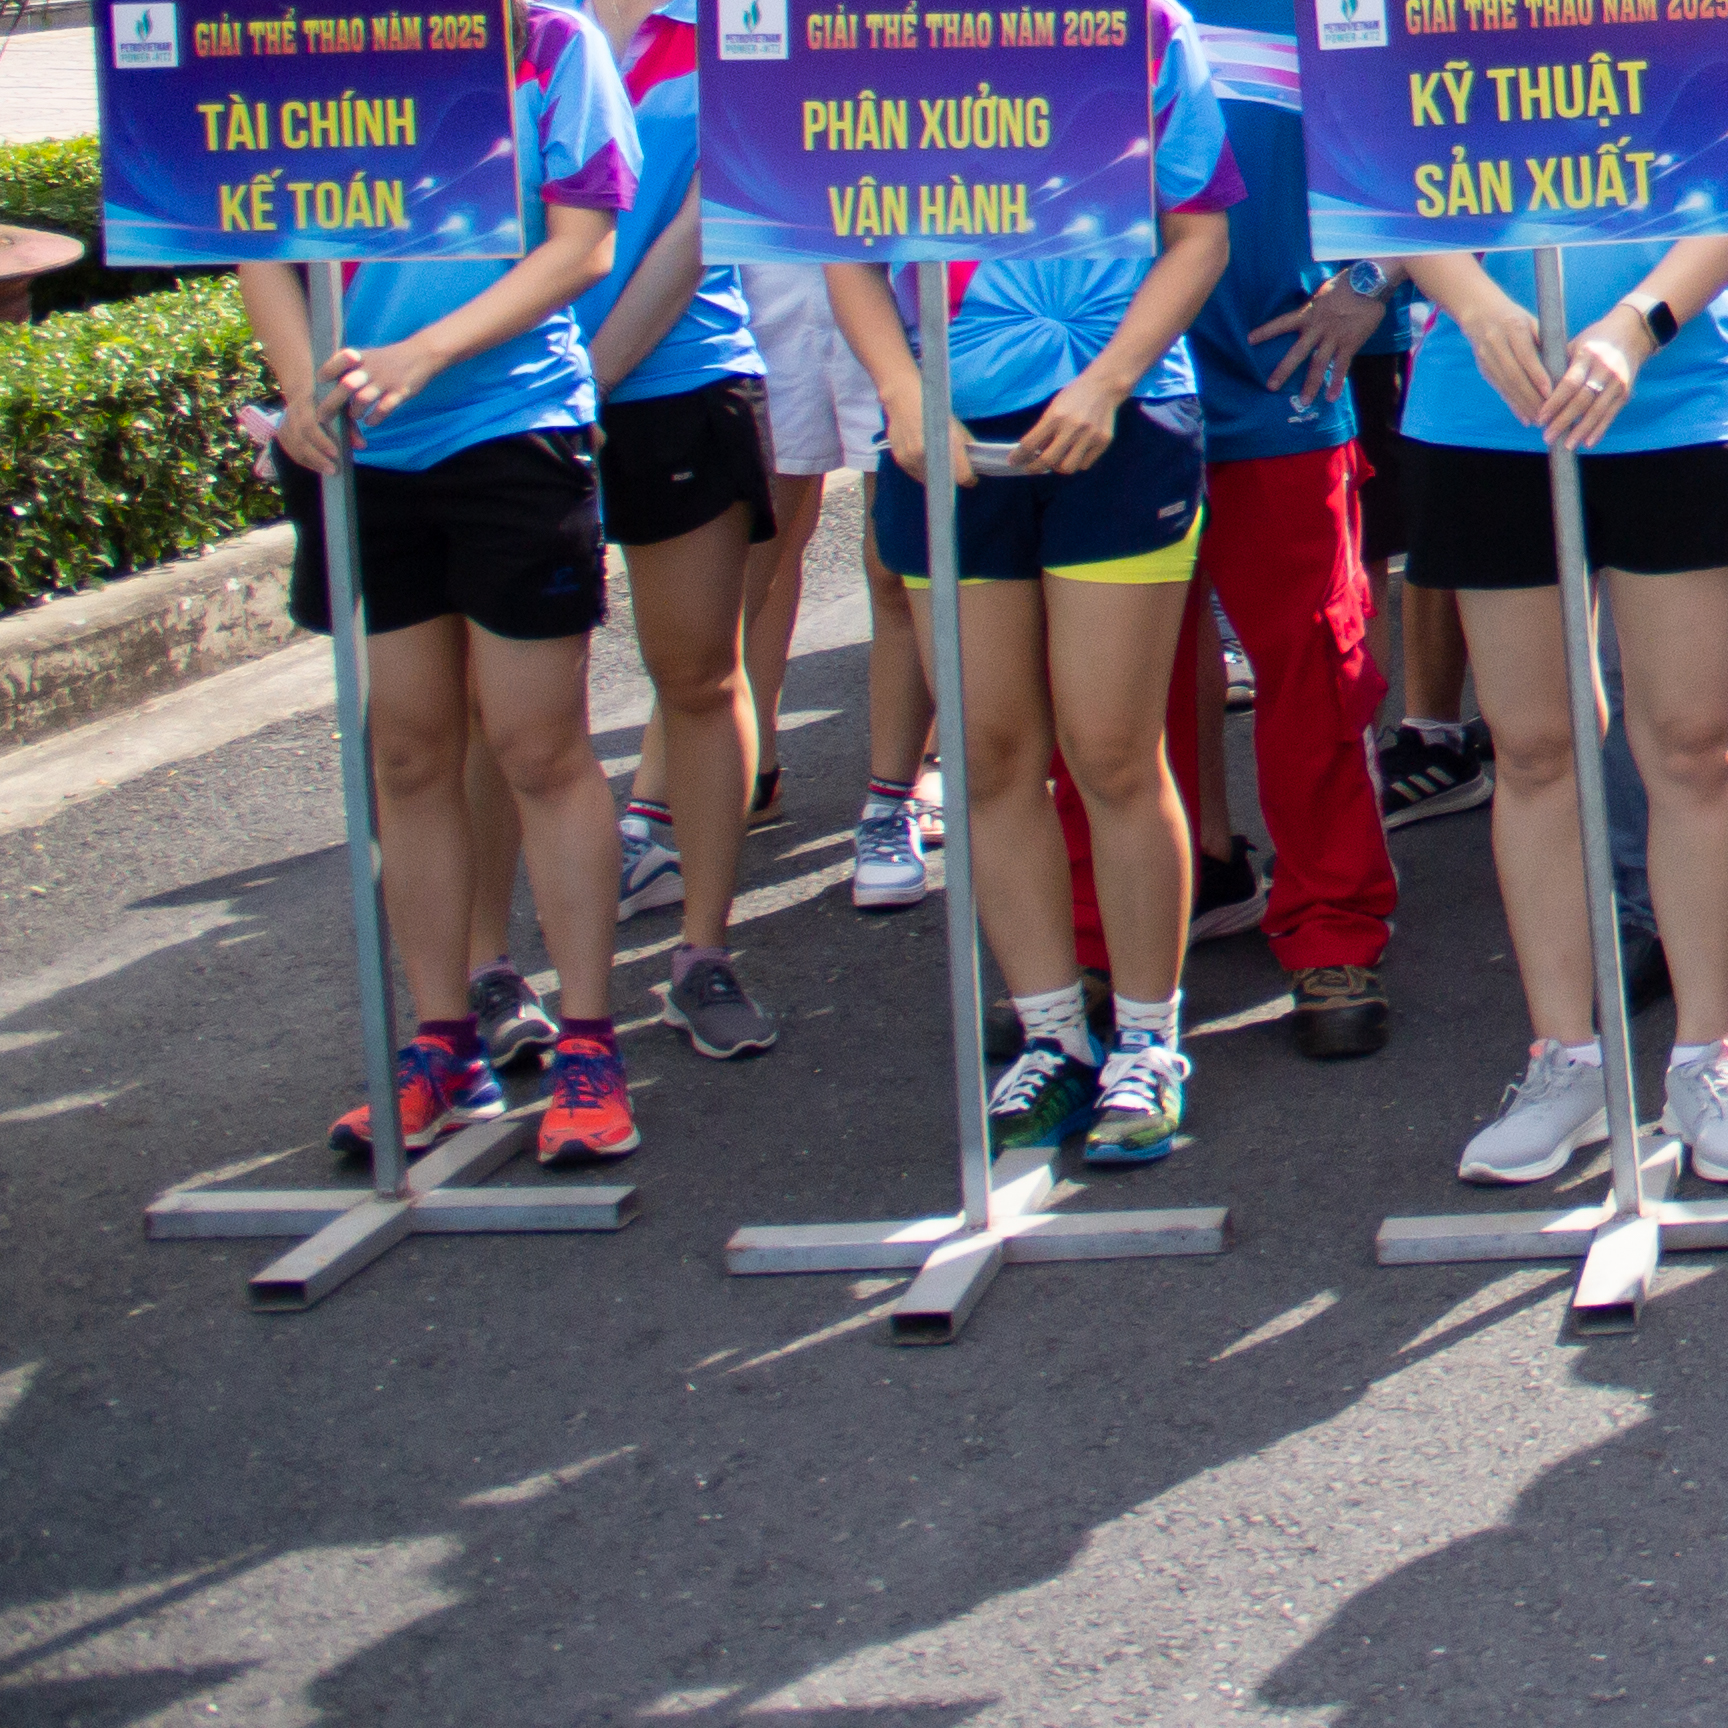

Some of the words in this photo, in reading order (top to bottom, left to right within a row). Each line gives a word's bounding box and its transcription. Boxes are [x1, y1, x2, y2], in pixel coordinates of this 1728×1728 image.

[194, 13, 241, 57] GIẢI
[249, 7, 296, 55] THỂ
[303, 18, 365, 53] THAO
[372, 12, 421, 52] NĂM
[429, 15, 486, 50] 2025
[807, 3, 857, 49] GIẢI
[866, 0, 918, 49] THỂ
[925, 12, 991, 48] THAO
[1000, 7, 1055, 47] NĂM
[1063, 10, 1127, 46] 2025
[198, 94, 268, 151] TÀI
[281, 91, 416, 149] CHÍNH
[803, 90, 907, 150] PHÂN
[919, 82, 1050, 148] XƯỞNG
[1410, 61, 1475, 126] KỸ
[1487, 52, 1648, 126] THUẬT
[219, 169, 283, 231] KẾ
[288, 172, 405, 229] TOÁN
[1416, 146, 1512, 218] SẢN
[1526, 137, 1654, 211] XUẤT
[829, 177, 907, 246] VẬN
[919, 175, 1027, 235] HÀNH
